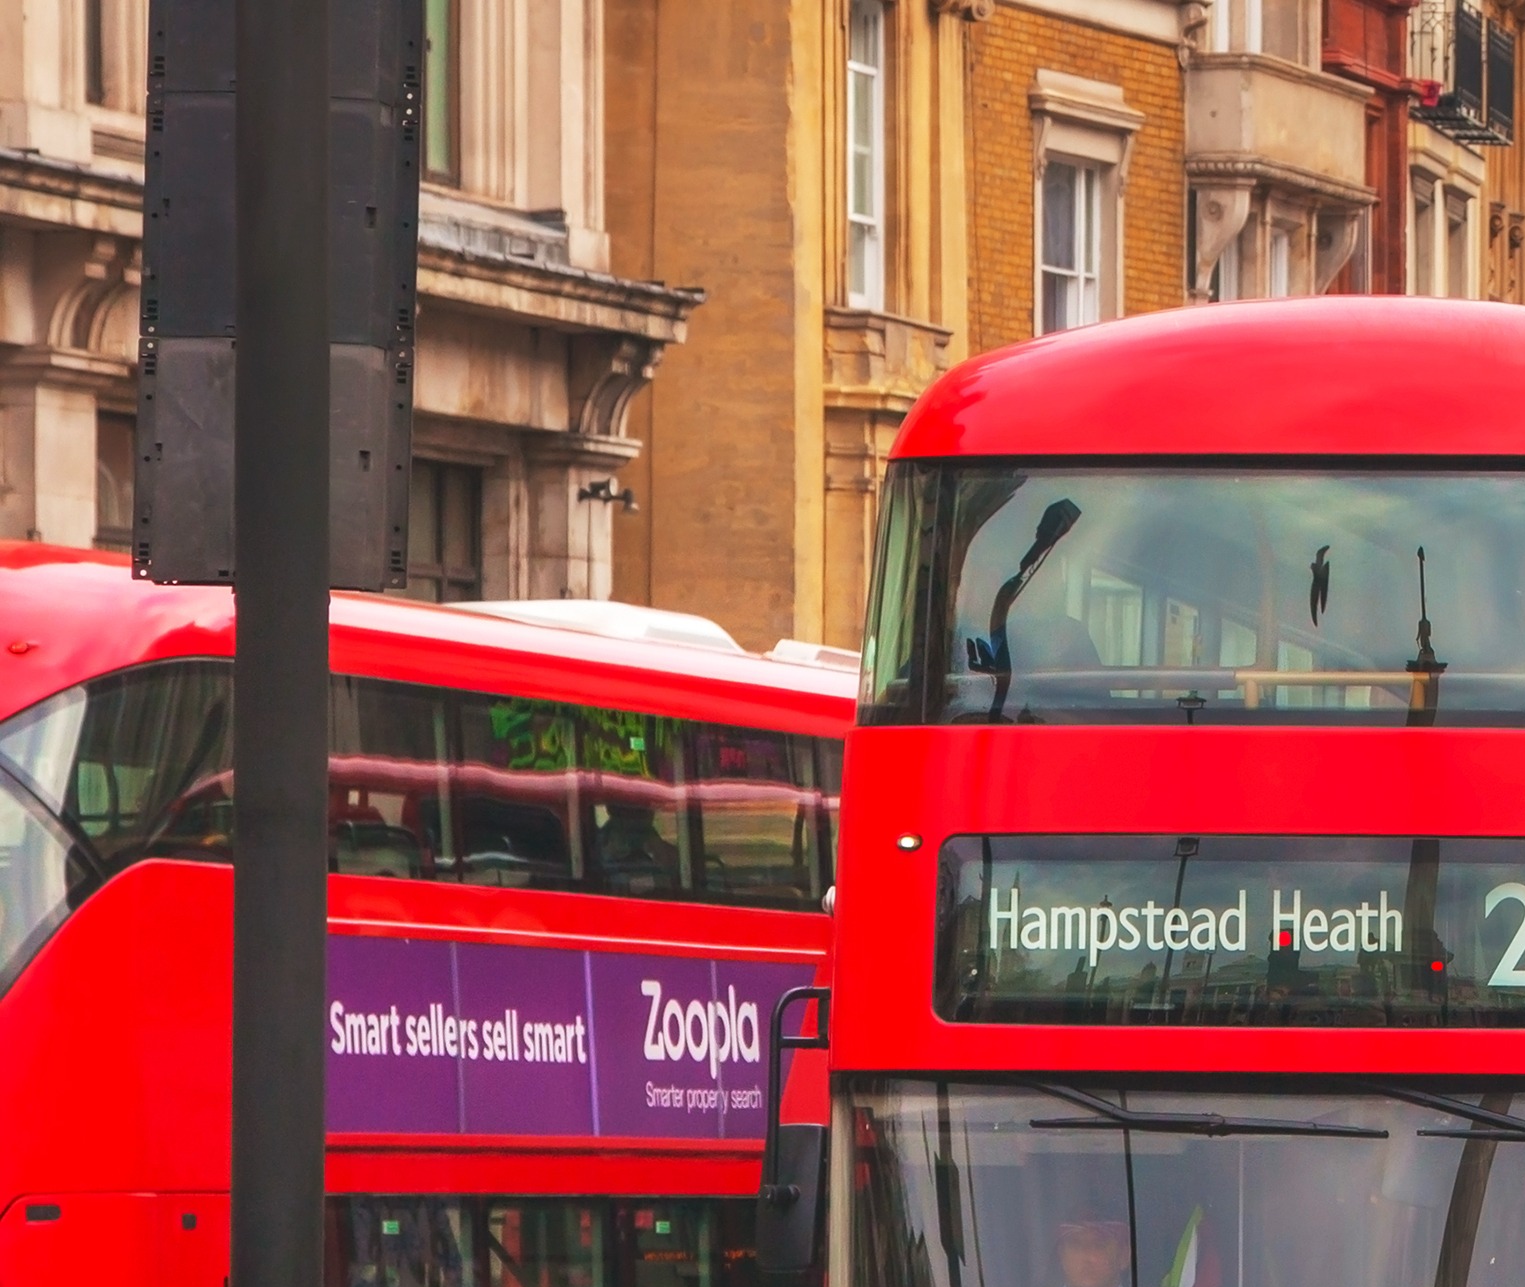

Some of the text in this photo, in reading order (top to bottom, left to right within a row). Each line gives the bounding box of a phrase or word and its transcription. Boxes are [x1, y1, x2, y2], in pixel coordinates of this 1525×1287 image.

[988, 888, 1402, 967] Hampstead Heath
[329, 1000, 588, 1063] Smart sellers sell smart
[641, 980, 760, 1080] Zoopla
[645, 1080, 684, 1108] Smarter
[730, 1084, 763, 1109] search
